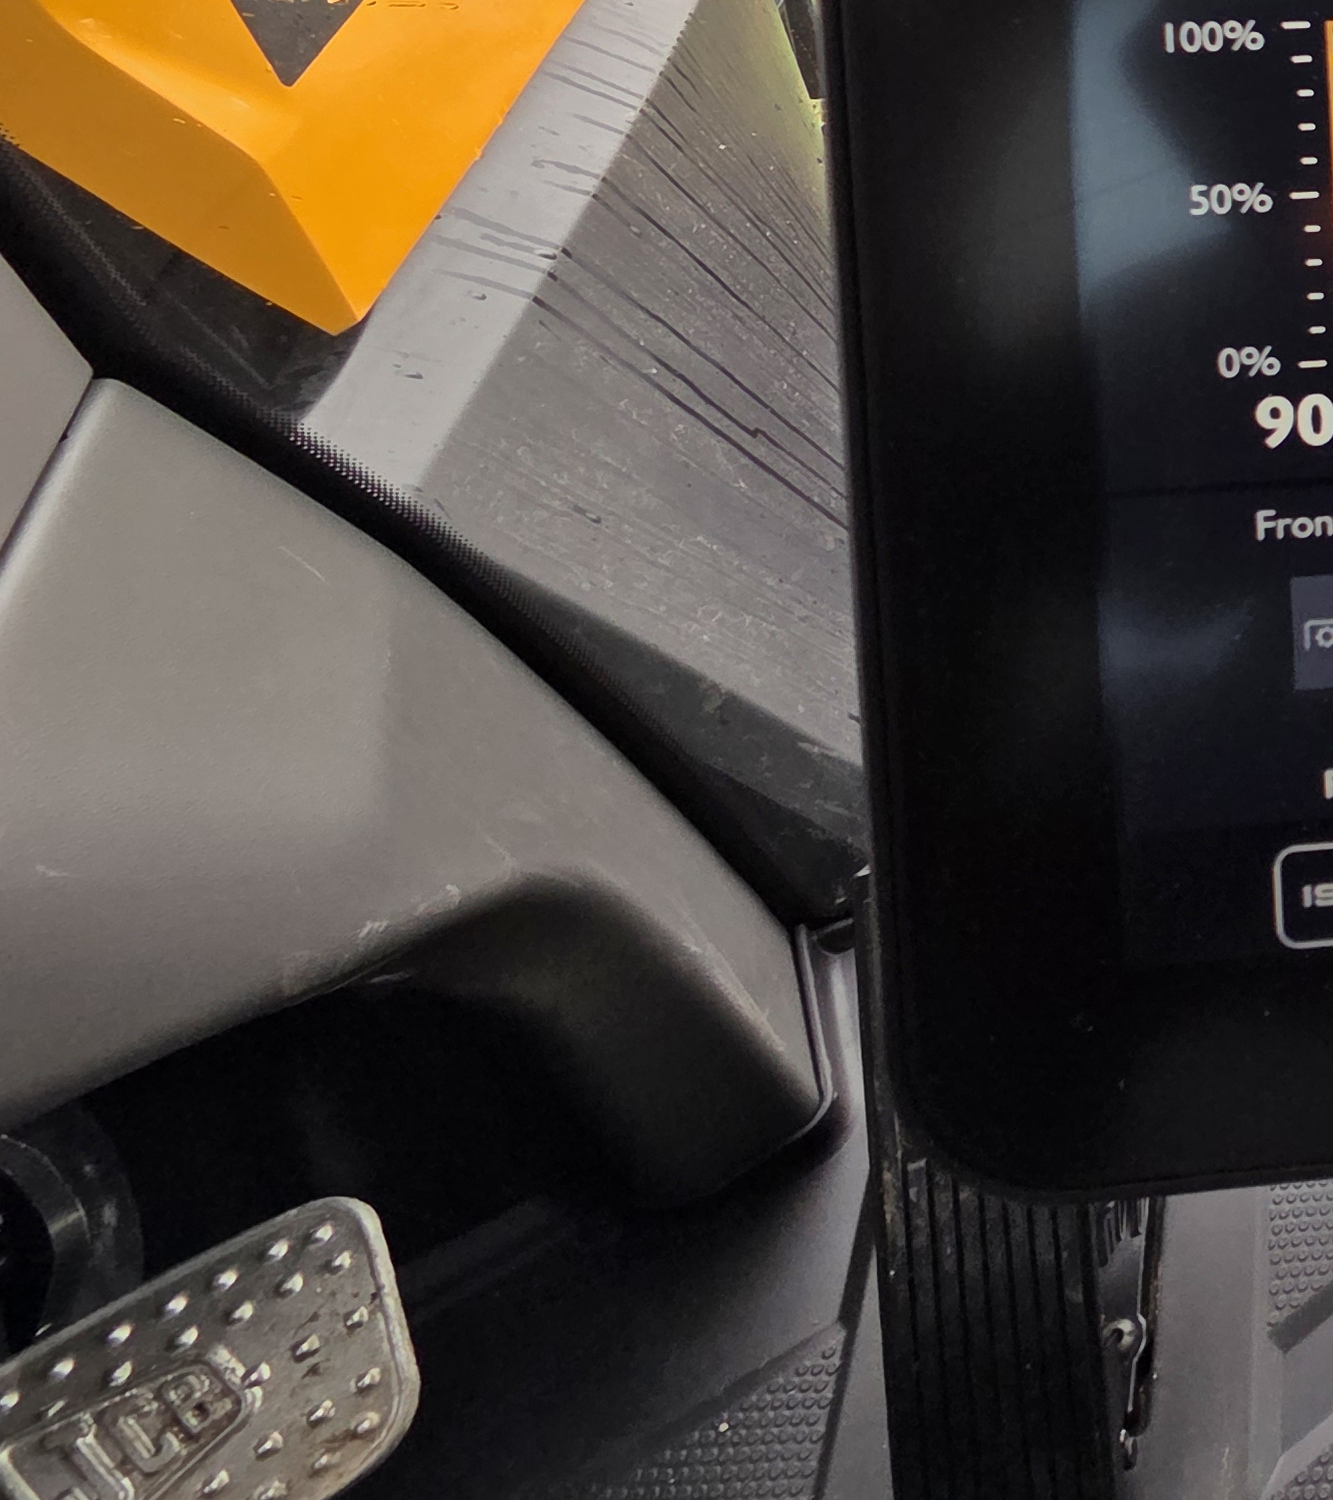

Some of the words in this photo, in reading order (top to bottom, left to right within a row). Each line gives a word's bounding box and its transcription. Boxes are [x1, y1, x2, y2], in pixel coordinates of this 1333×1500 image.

[1162, 18, 1265, 54] 100%
[1190, 182, 1273, 216] 50%
[1218, 345, 1281, 377] 0%
